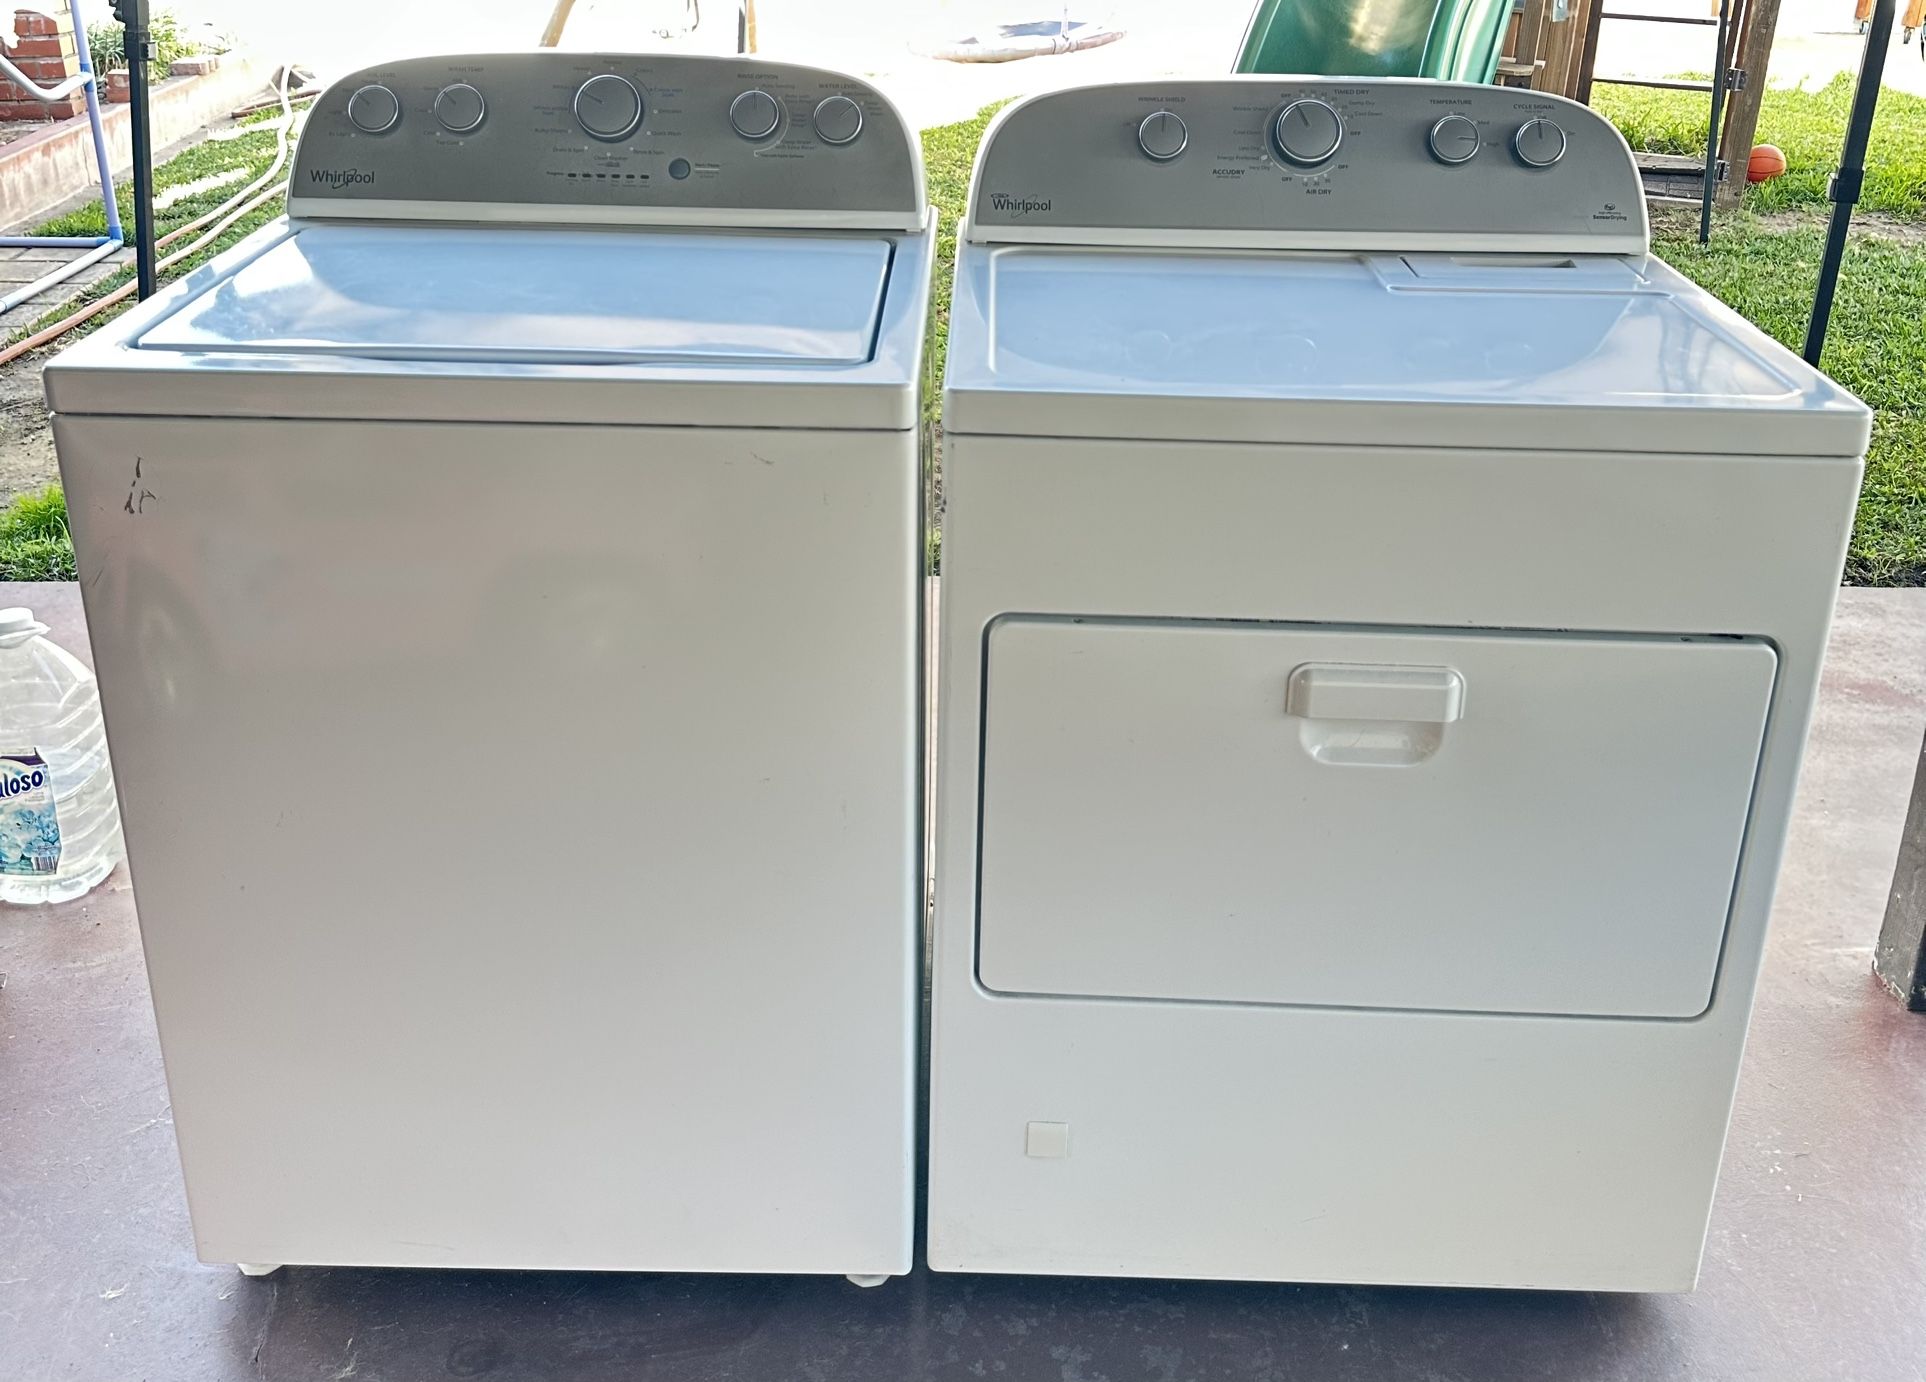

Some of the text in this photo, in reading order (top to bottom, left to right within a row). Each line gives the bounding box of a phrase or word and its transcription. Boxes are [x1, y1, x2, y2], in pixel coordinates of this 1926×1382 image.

[310, 169, 375, 188] Whirlpool
[992, 198, 1052, 215] Whirlpool
[1592, 214, 1628, 222] SensorDrying
[0, 770, 44, 798] loso
